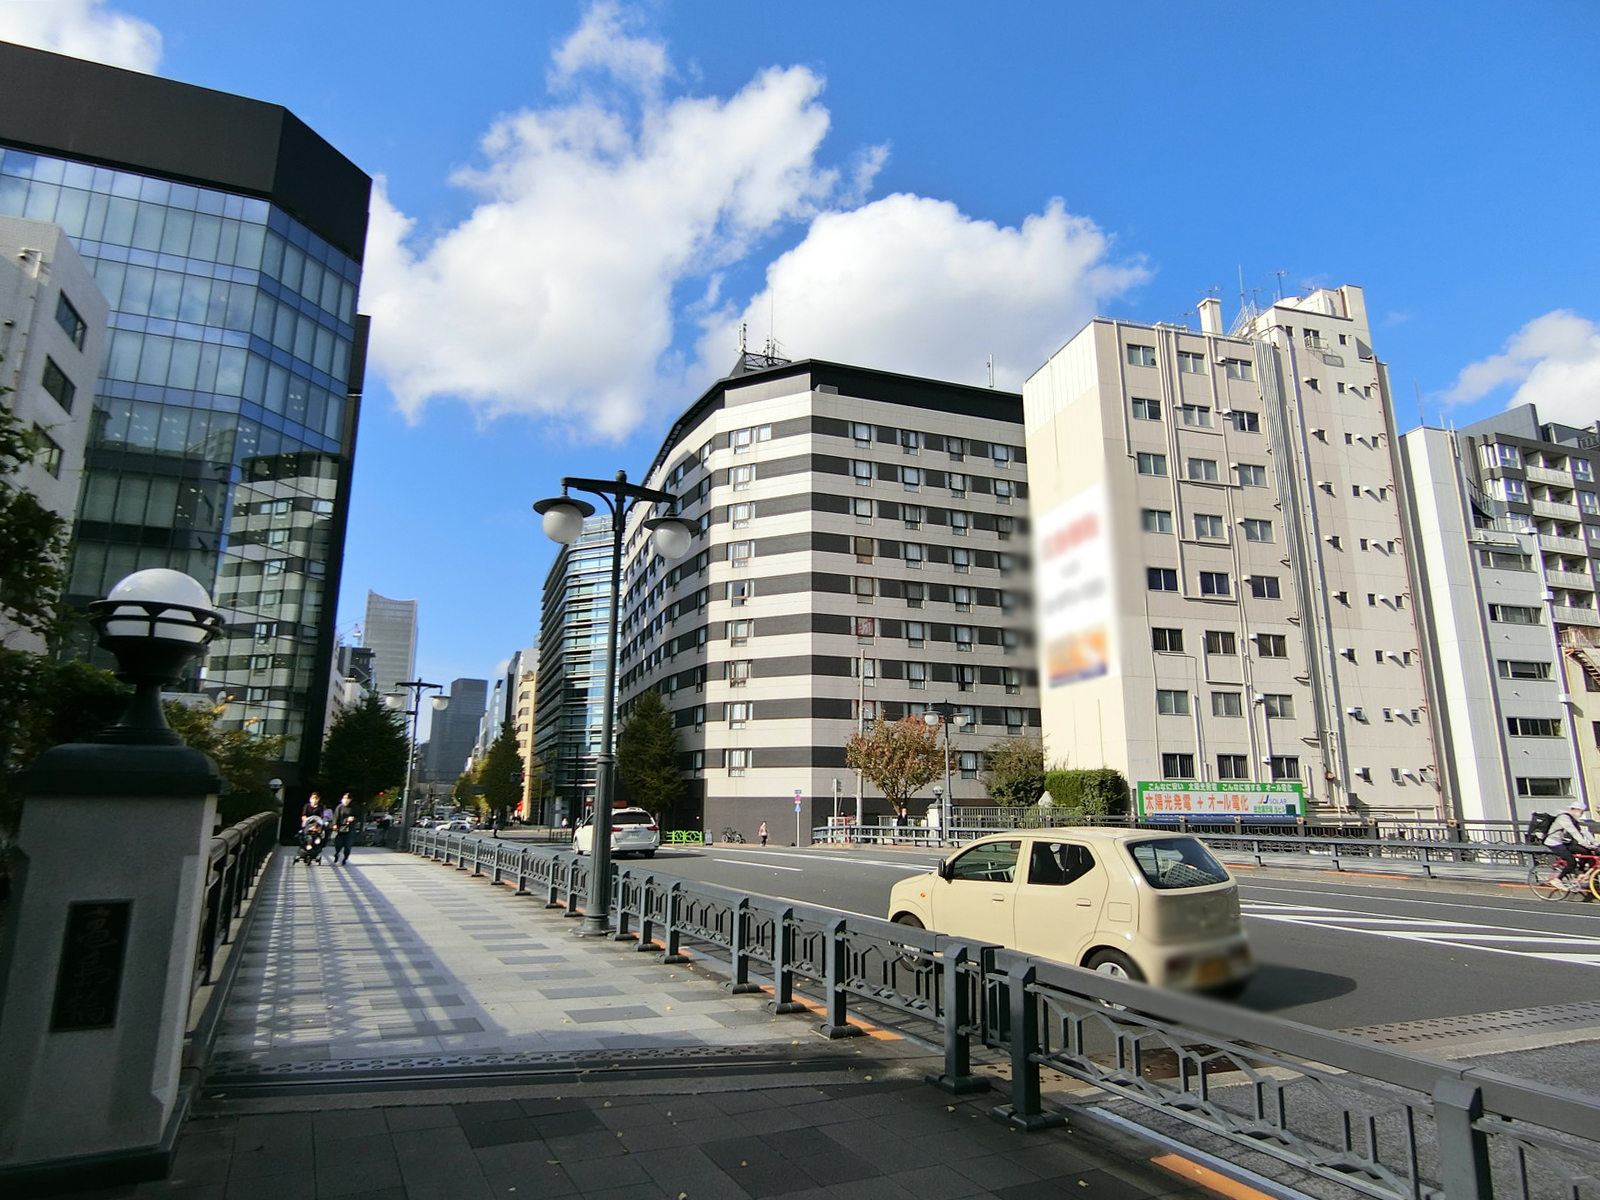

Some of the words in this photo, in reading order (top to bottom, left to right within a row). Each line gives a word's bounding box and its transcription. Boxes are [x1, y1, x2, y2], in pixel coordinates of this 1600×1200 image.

[1265, 784, 1293, 792] オール電化
[1145, 794, 1192, 811] 太陽光発電
[1208, 794, 1250, 812] オール電化
